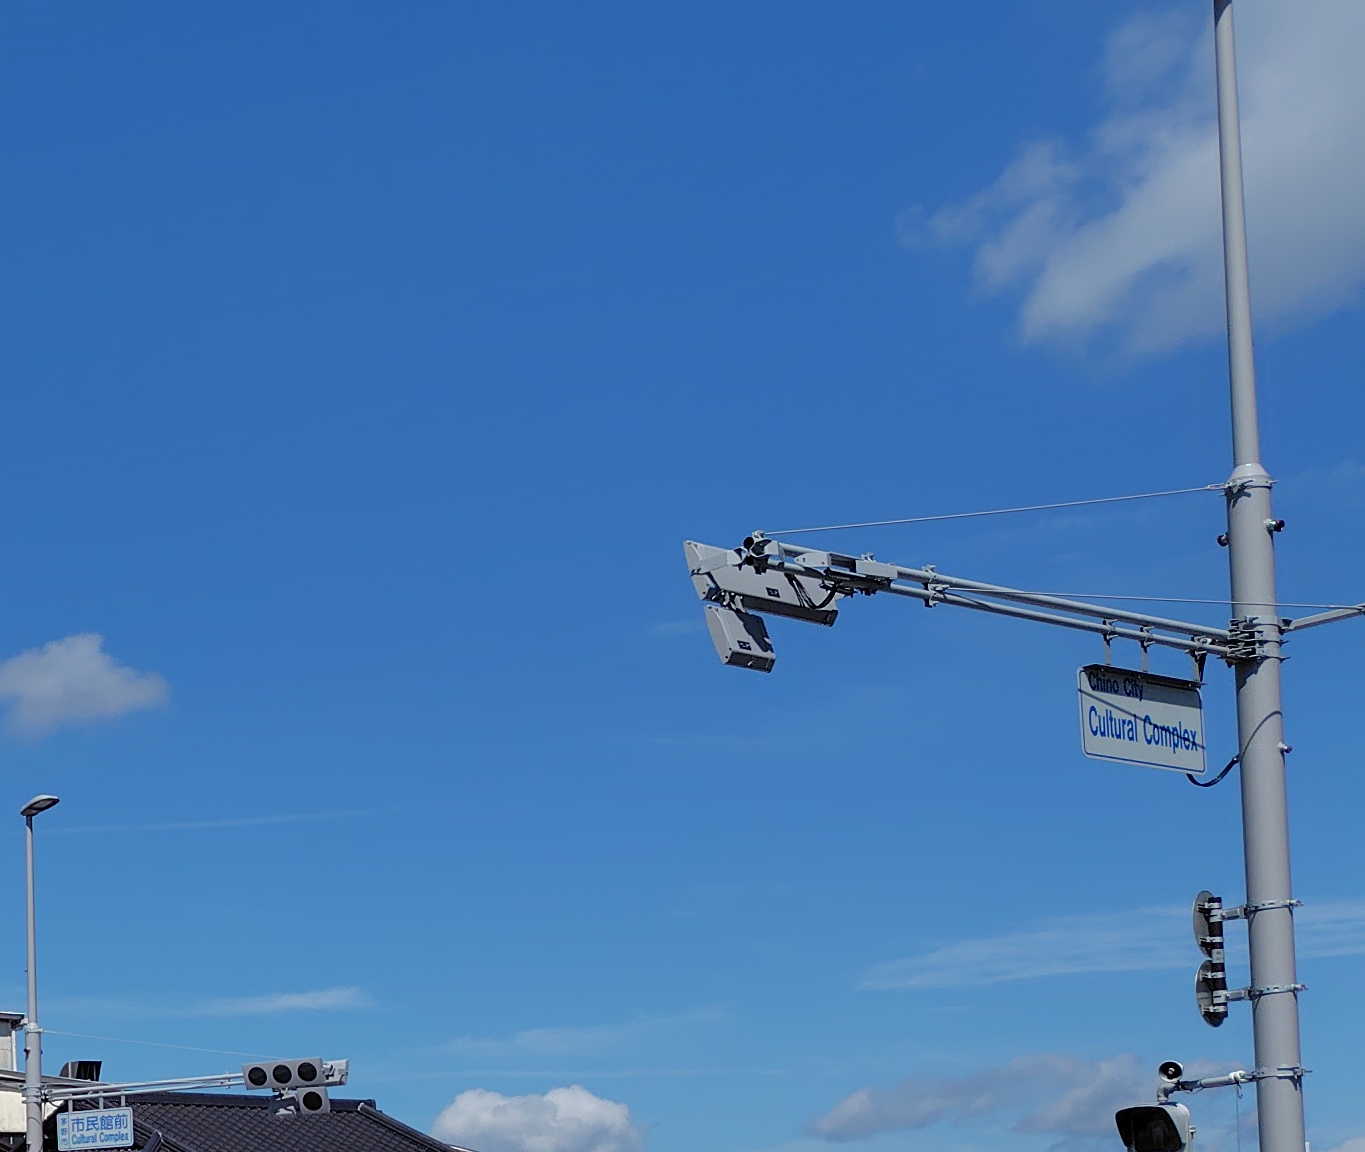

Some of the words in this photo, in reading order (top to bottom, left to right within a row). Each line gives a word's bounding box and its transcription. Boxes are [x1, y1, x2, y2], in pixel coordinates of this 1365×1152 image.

[1089, 671, 1120, 694] Chino
[1123, 677, 1144, 702] City
[1089, 705, 1138, 742] Cultural
[1143, 714, 1199, 754] Complex
[71, 1113, 128, 1133] 市民館前
[72, 1132, 98, 1145] Cultural
[100, 1130, 129, 1143] Complex
